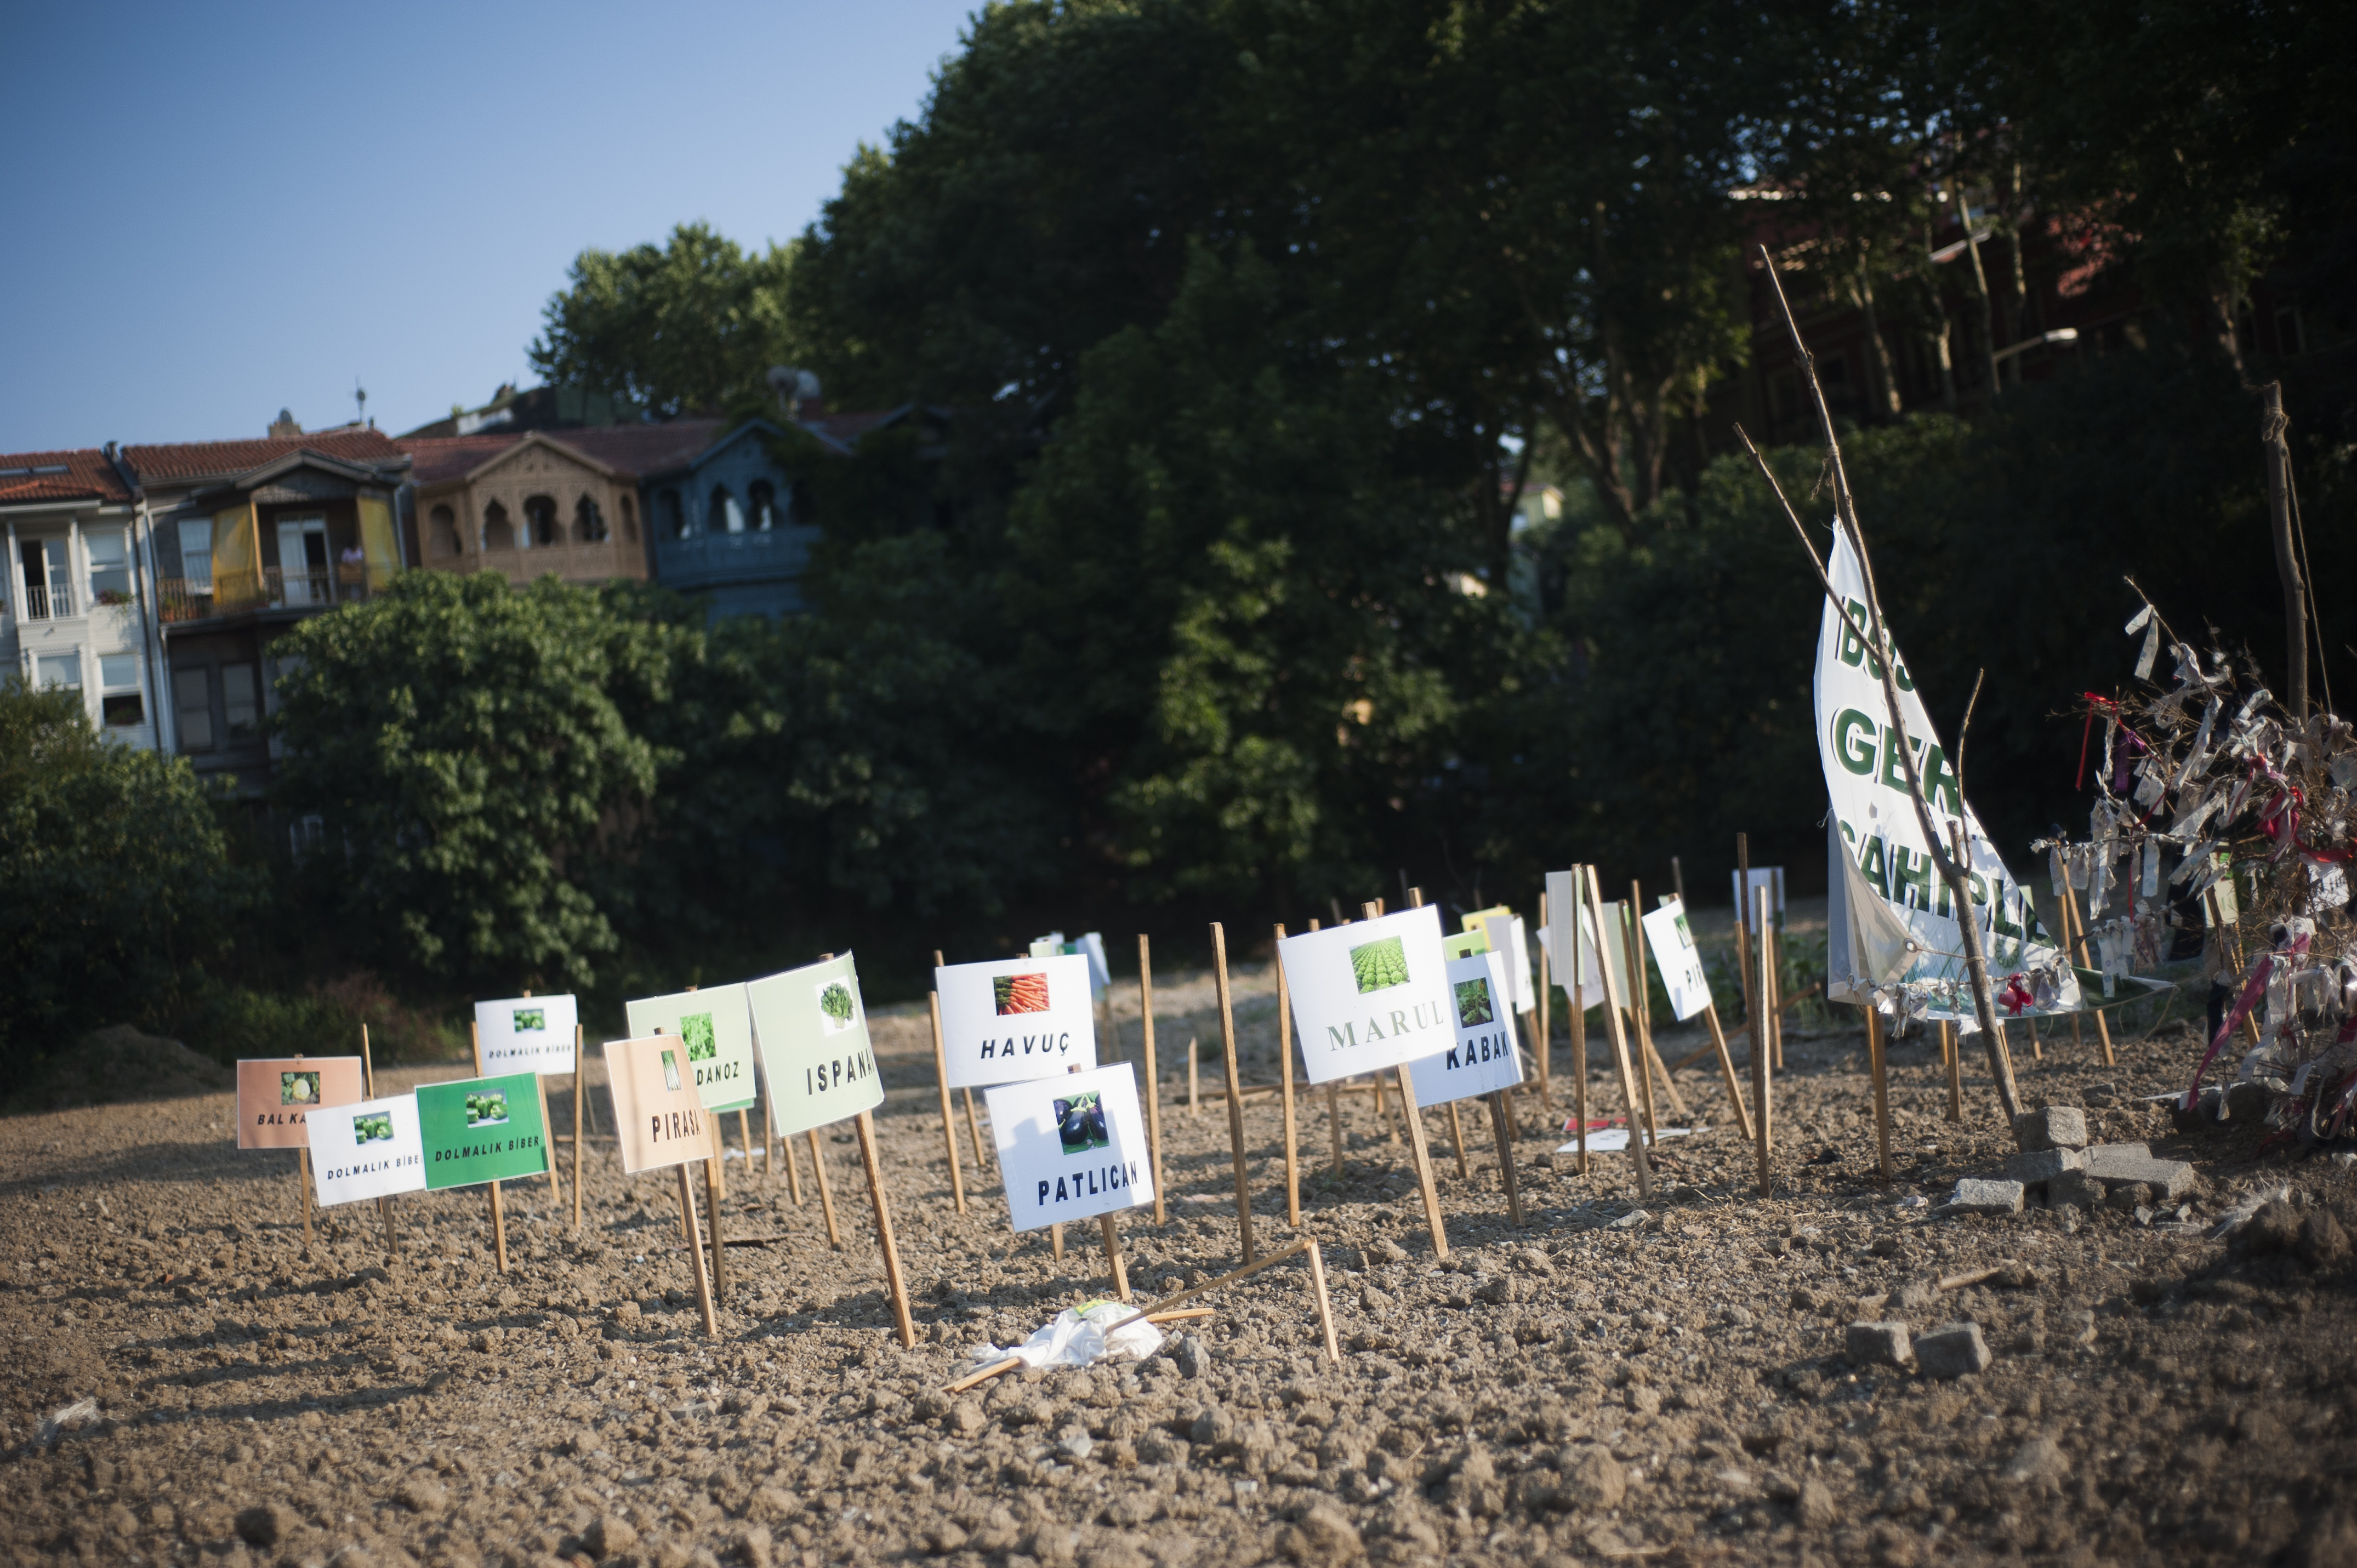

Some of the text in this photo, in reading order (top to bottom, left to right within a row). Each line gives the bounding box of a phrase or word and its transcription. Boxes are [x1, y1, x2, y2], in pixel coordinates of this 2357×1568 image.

[1325, 1000, 1444, 1052] MARUL
[489, 1047, 539, 1059] DOLMALIK
[981, 1032, 1069, 1057] HAVUÇ
[1447, 1031, 1508, 1070] KABAK
[697, 1060, 739, 1086] DANOZ
[652, 1109, 701, 1143] PIRASA
[435, 1136, 539, 1162] DOLMALIK BİBER
[328, 1160, 390, 1179] DOLMALIK
[1038, 1160, 1138, 1206] PATLICAN
